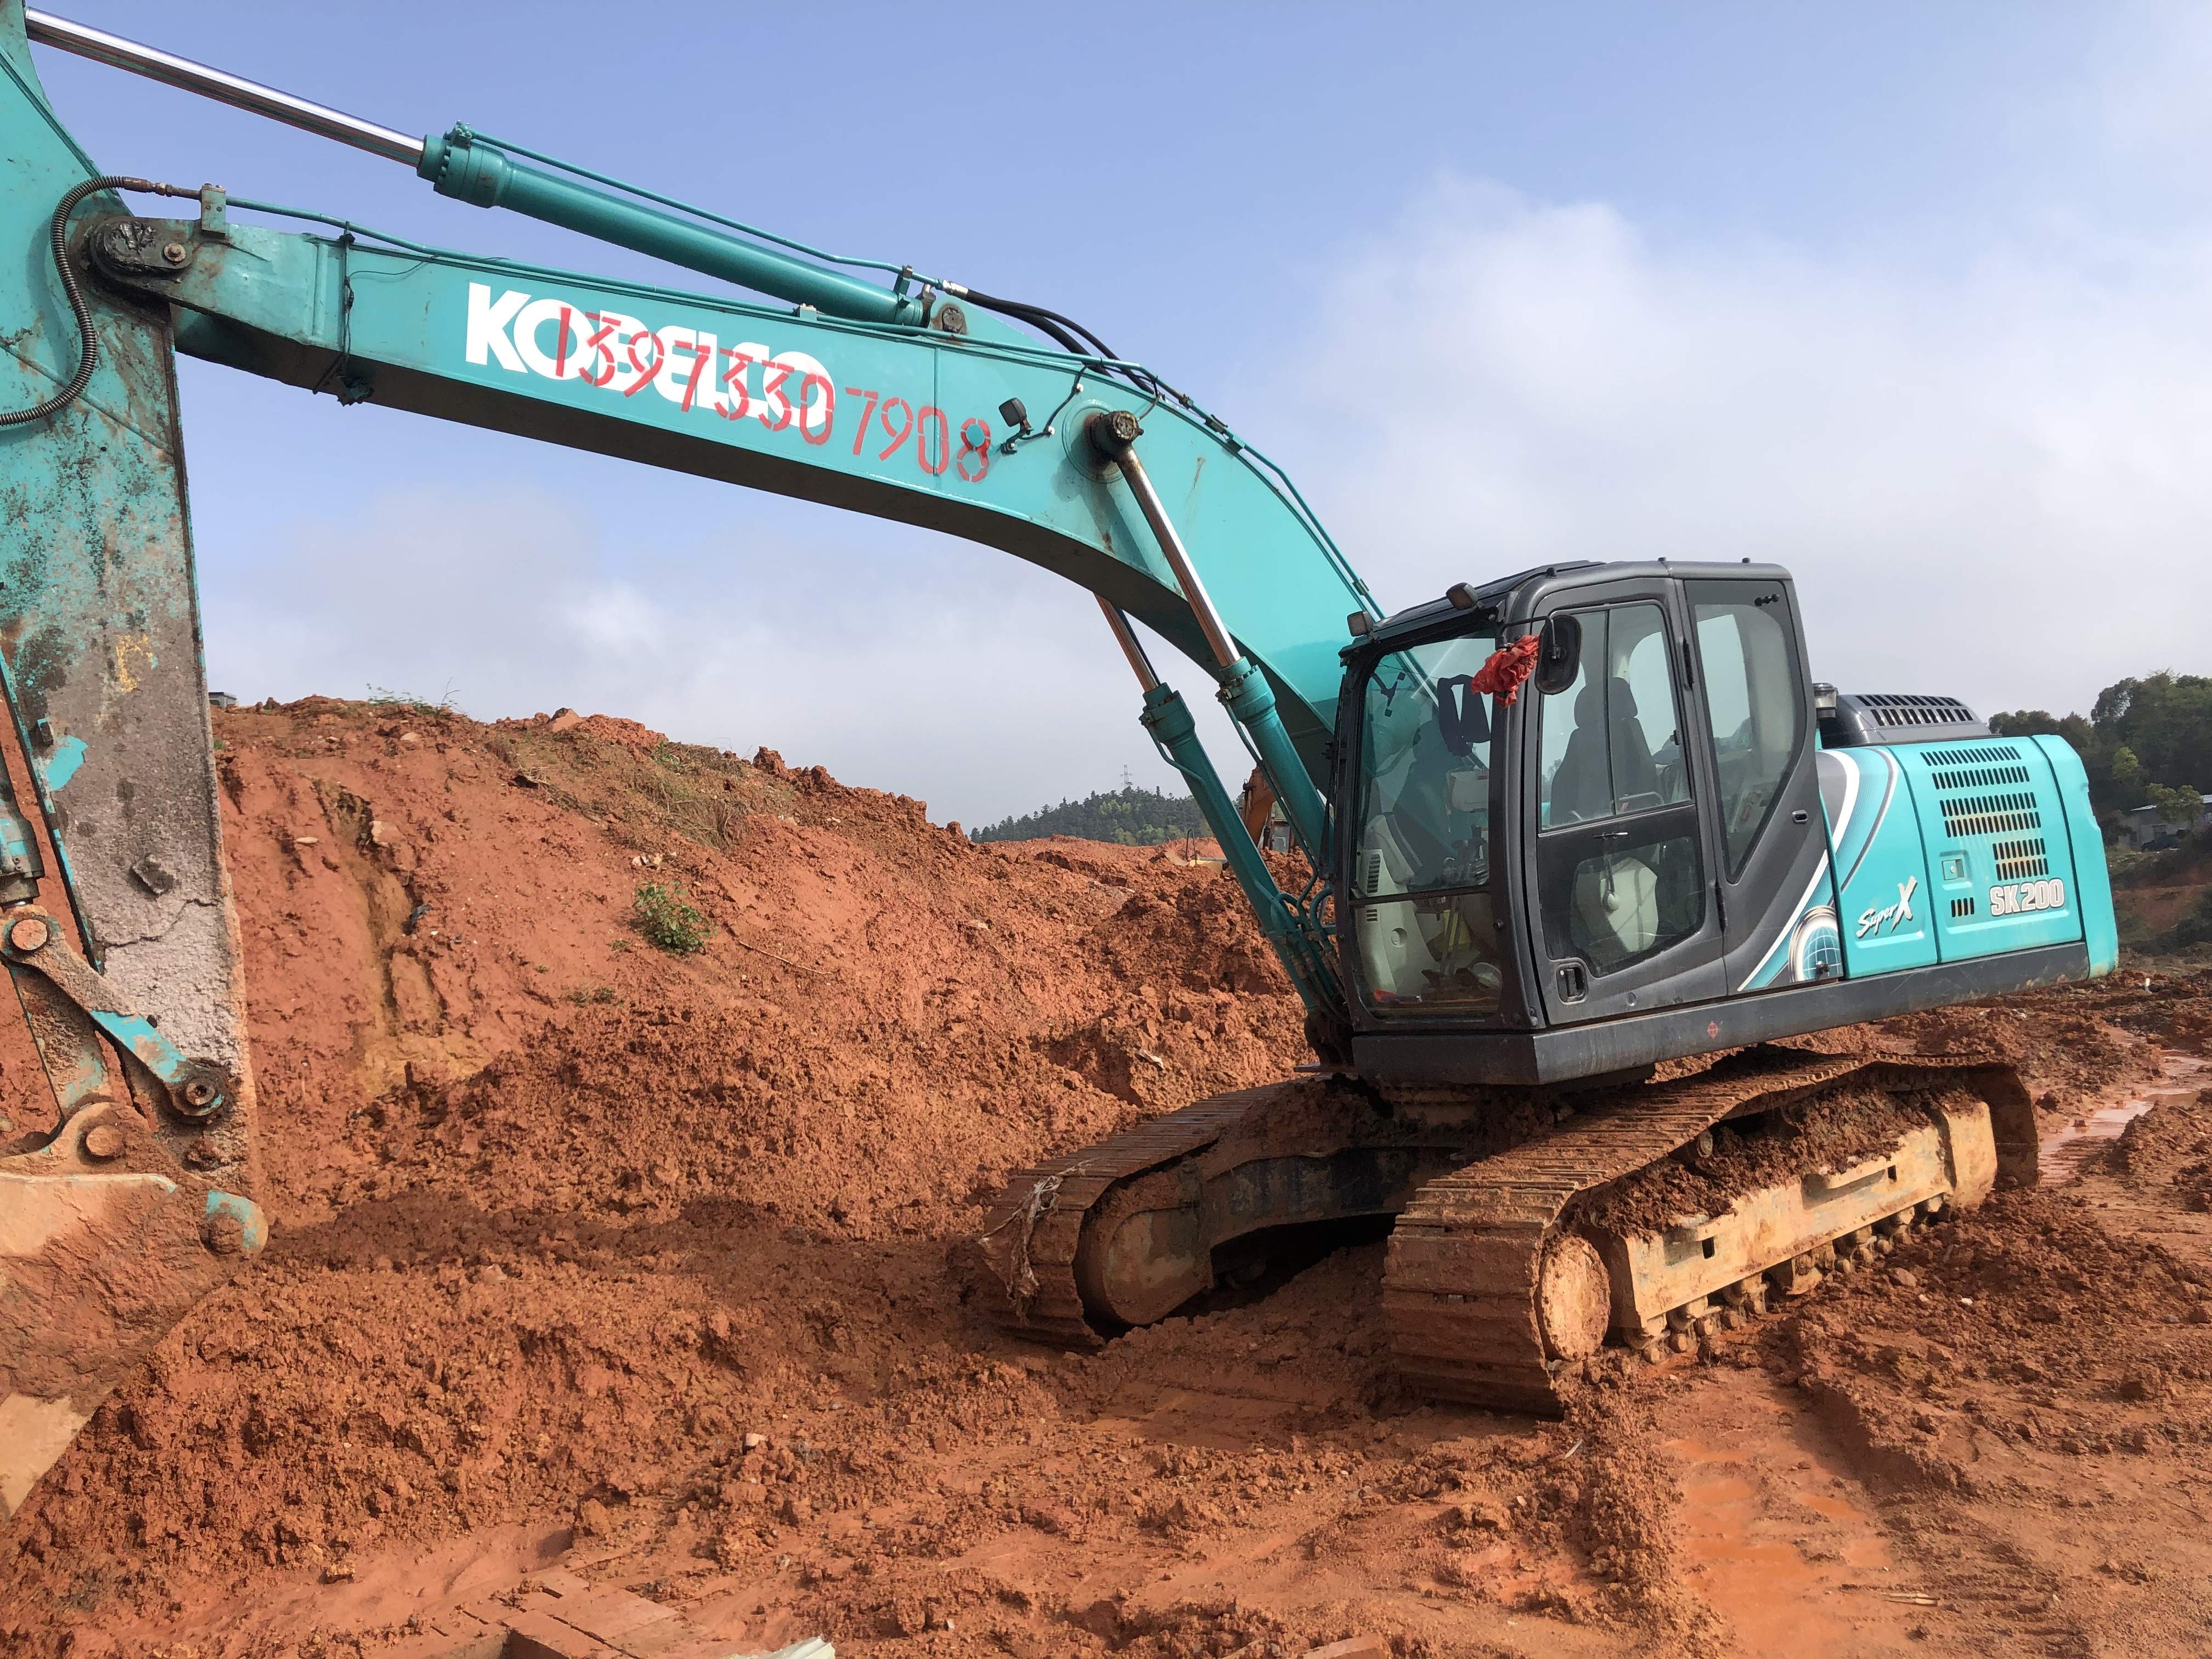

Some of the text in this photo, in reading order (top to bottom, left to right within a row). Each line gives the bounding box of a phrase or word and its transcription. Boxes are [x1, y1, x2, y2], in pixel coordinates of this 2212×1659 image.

[465, 282, 836, 428] KOBELCO
[555, 307, 991, 483] 13973307908
[1989, 878, 2065, 917] SK200
